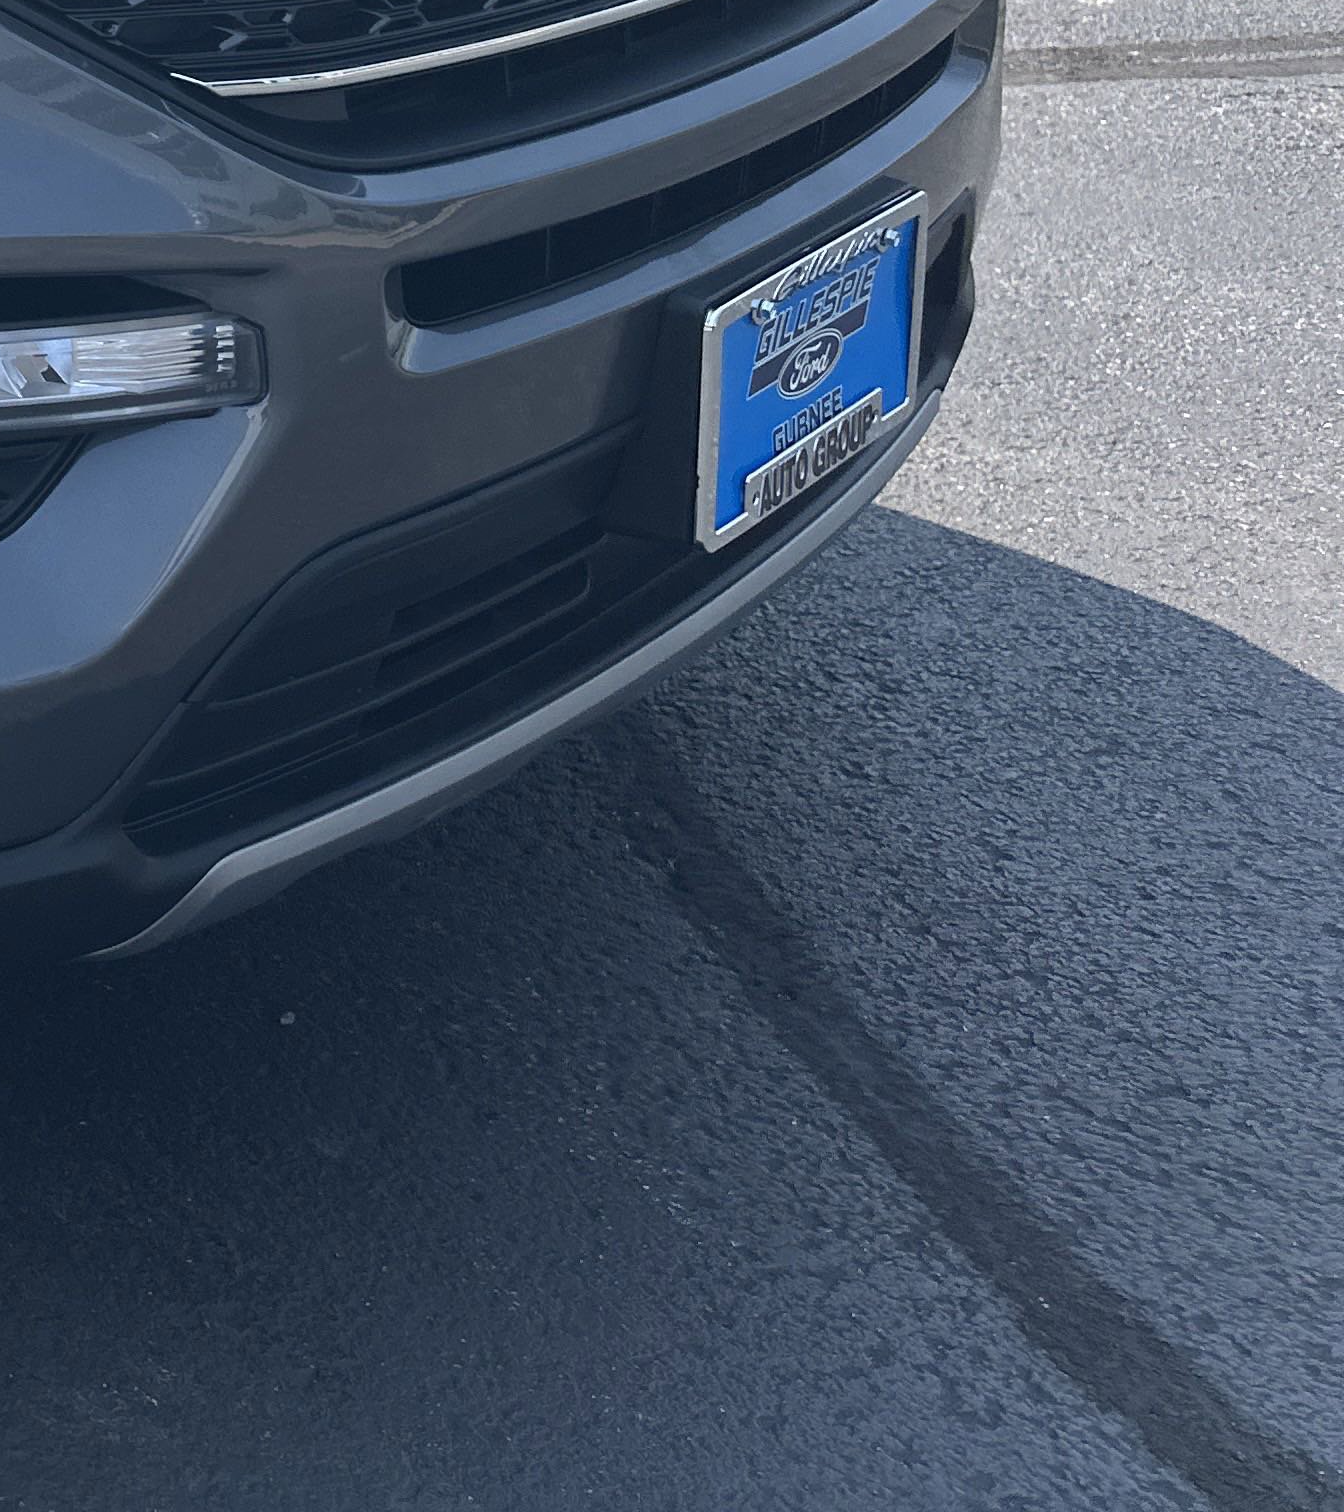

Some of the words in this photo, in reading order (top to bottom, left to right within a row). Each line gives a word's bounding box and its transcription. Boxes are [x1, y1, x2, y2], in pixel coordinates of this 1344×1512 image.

[753, 255, 881, 365] GILLESPIE
[789, 340, 832, 391] Ford
[760, 446, 808, 512] AUTO
[812, 403, 875, 477] GROUP
[771, 384, 844, 455] GURNEE
